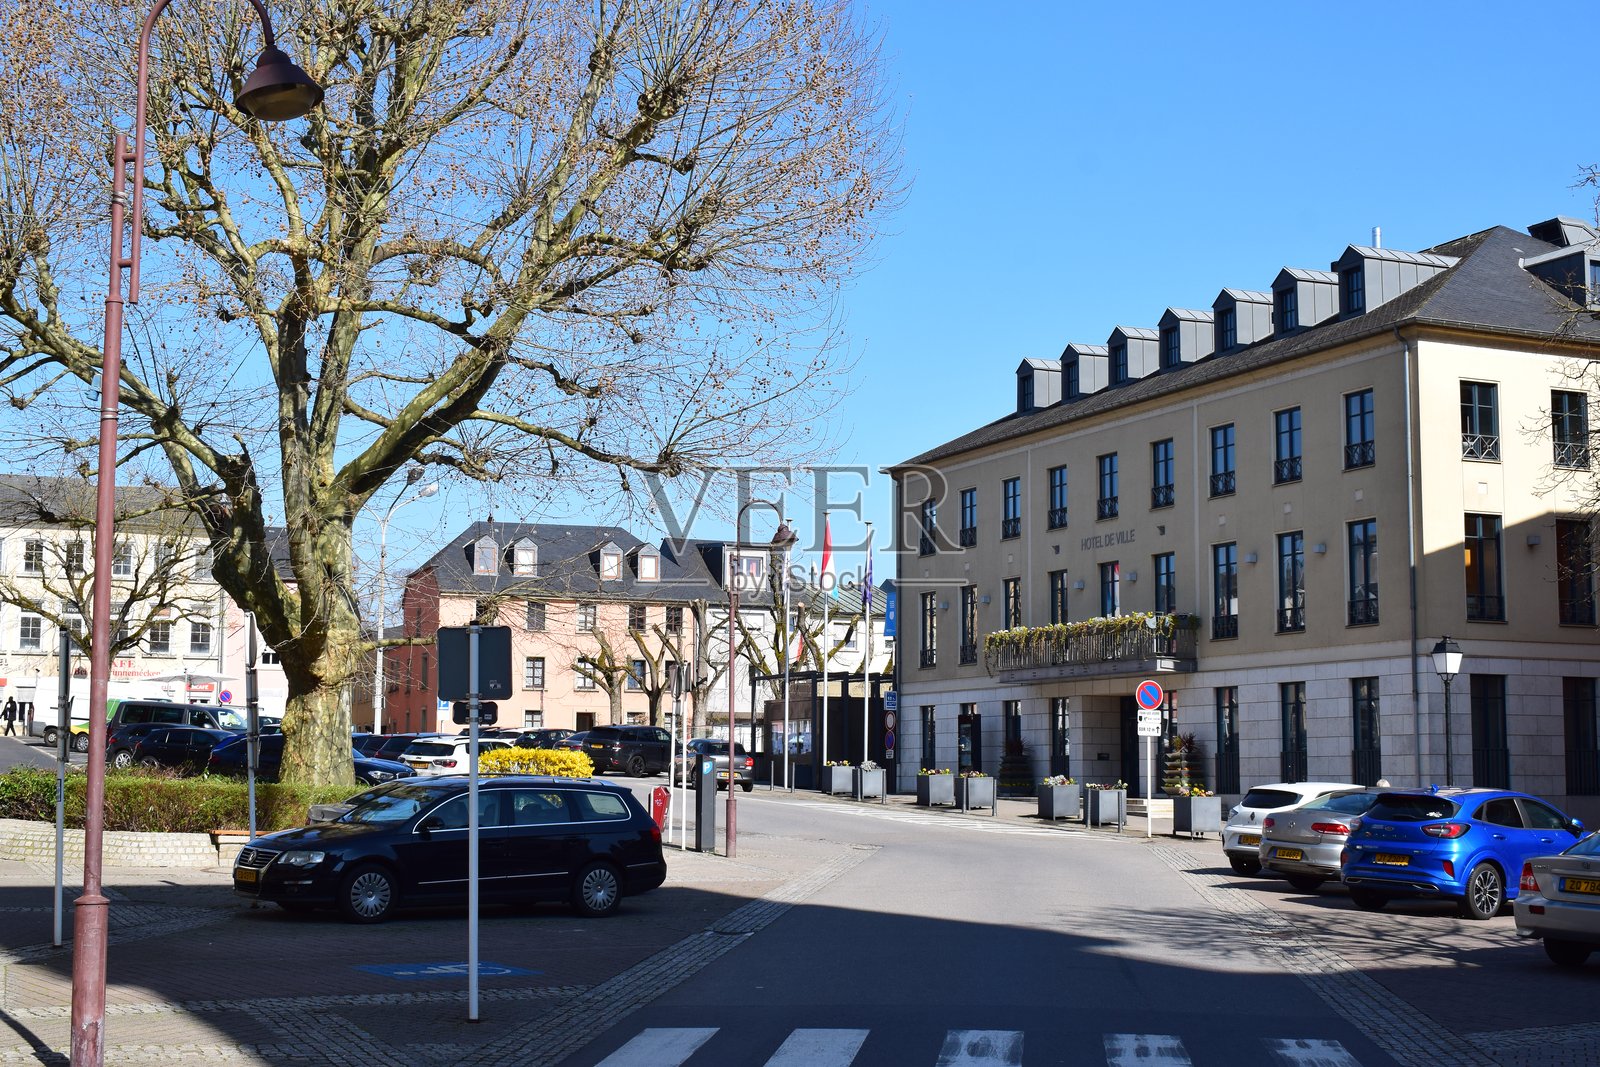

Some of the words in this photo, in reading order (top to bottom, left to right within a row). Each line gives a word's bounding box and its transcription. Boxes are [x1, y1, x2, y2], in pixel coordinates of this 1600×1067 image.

[1105, 532, 1115, 547] DE
[1116, 529, 1136, 544] VILLE
[112, 660, 136, 668] AFE
